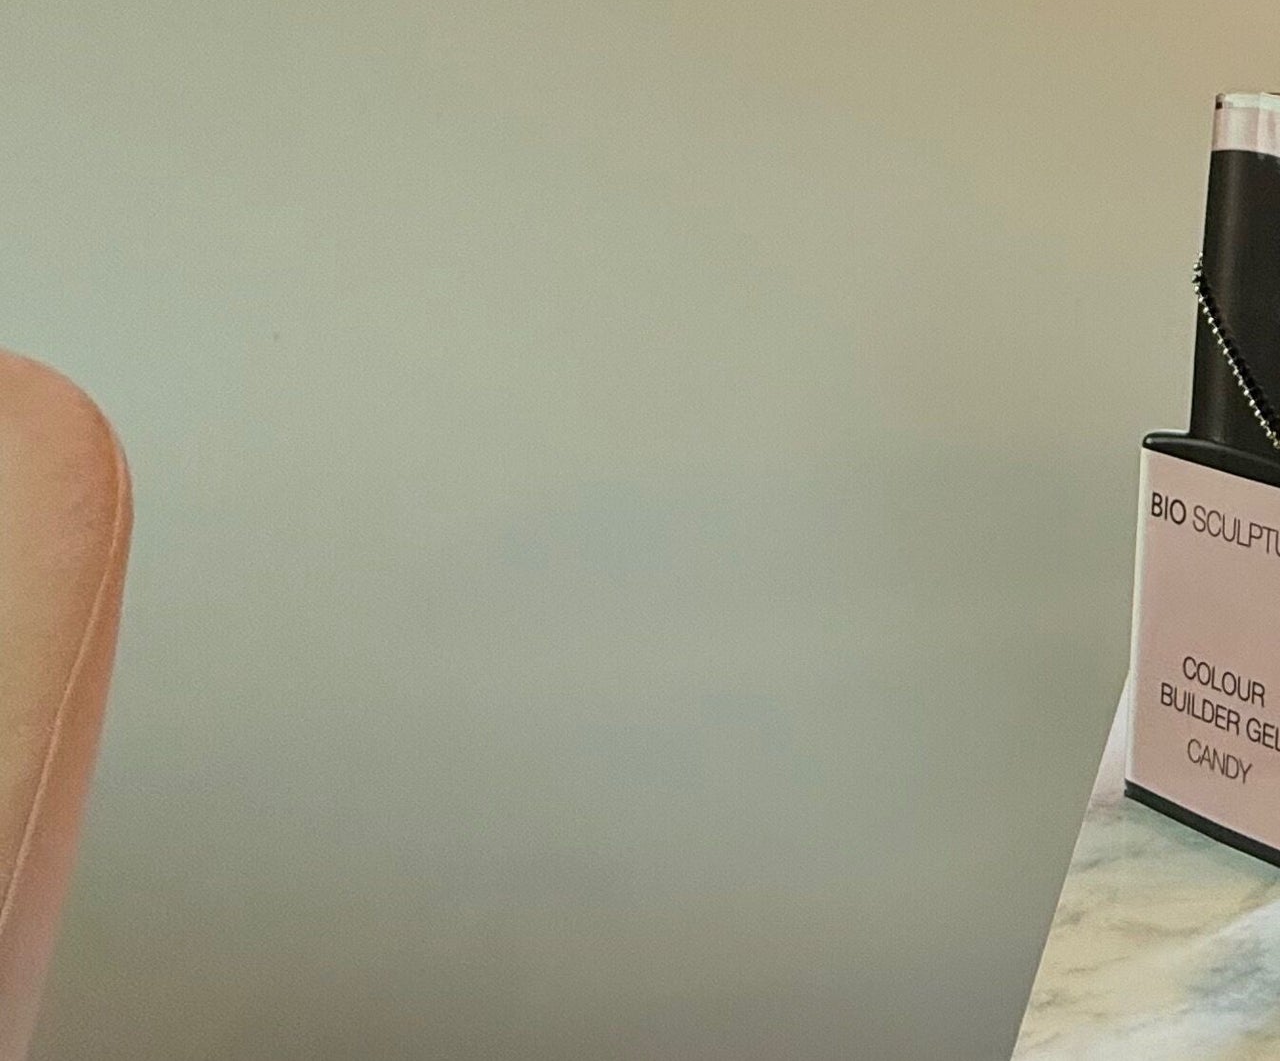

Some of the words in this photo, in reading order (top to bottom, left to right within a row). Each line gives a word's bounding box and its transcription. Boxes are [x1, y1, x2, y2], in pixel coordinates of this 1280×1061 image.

[1151, 492, 1187, 526] BIO
[1183, 656, 1266, 708] COLOUR
[1160, 683, 1240, 737] BUILDER
[1187, 739, 1253, 785] CANDY
